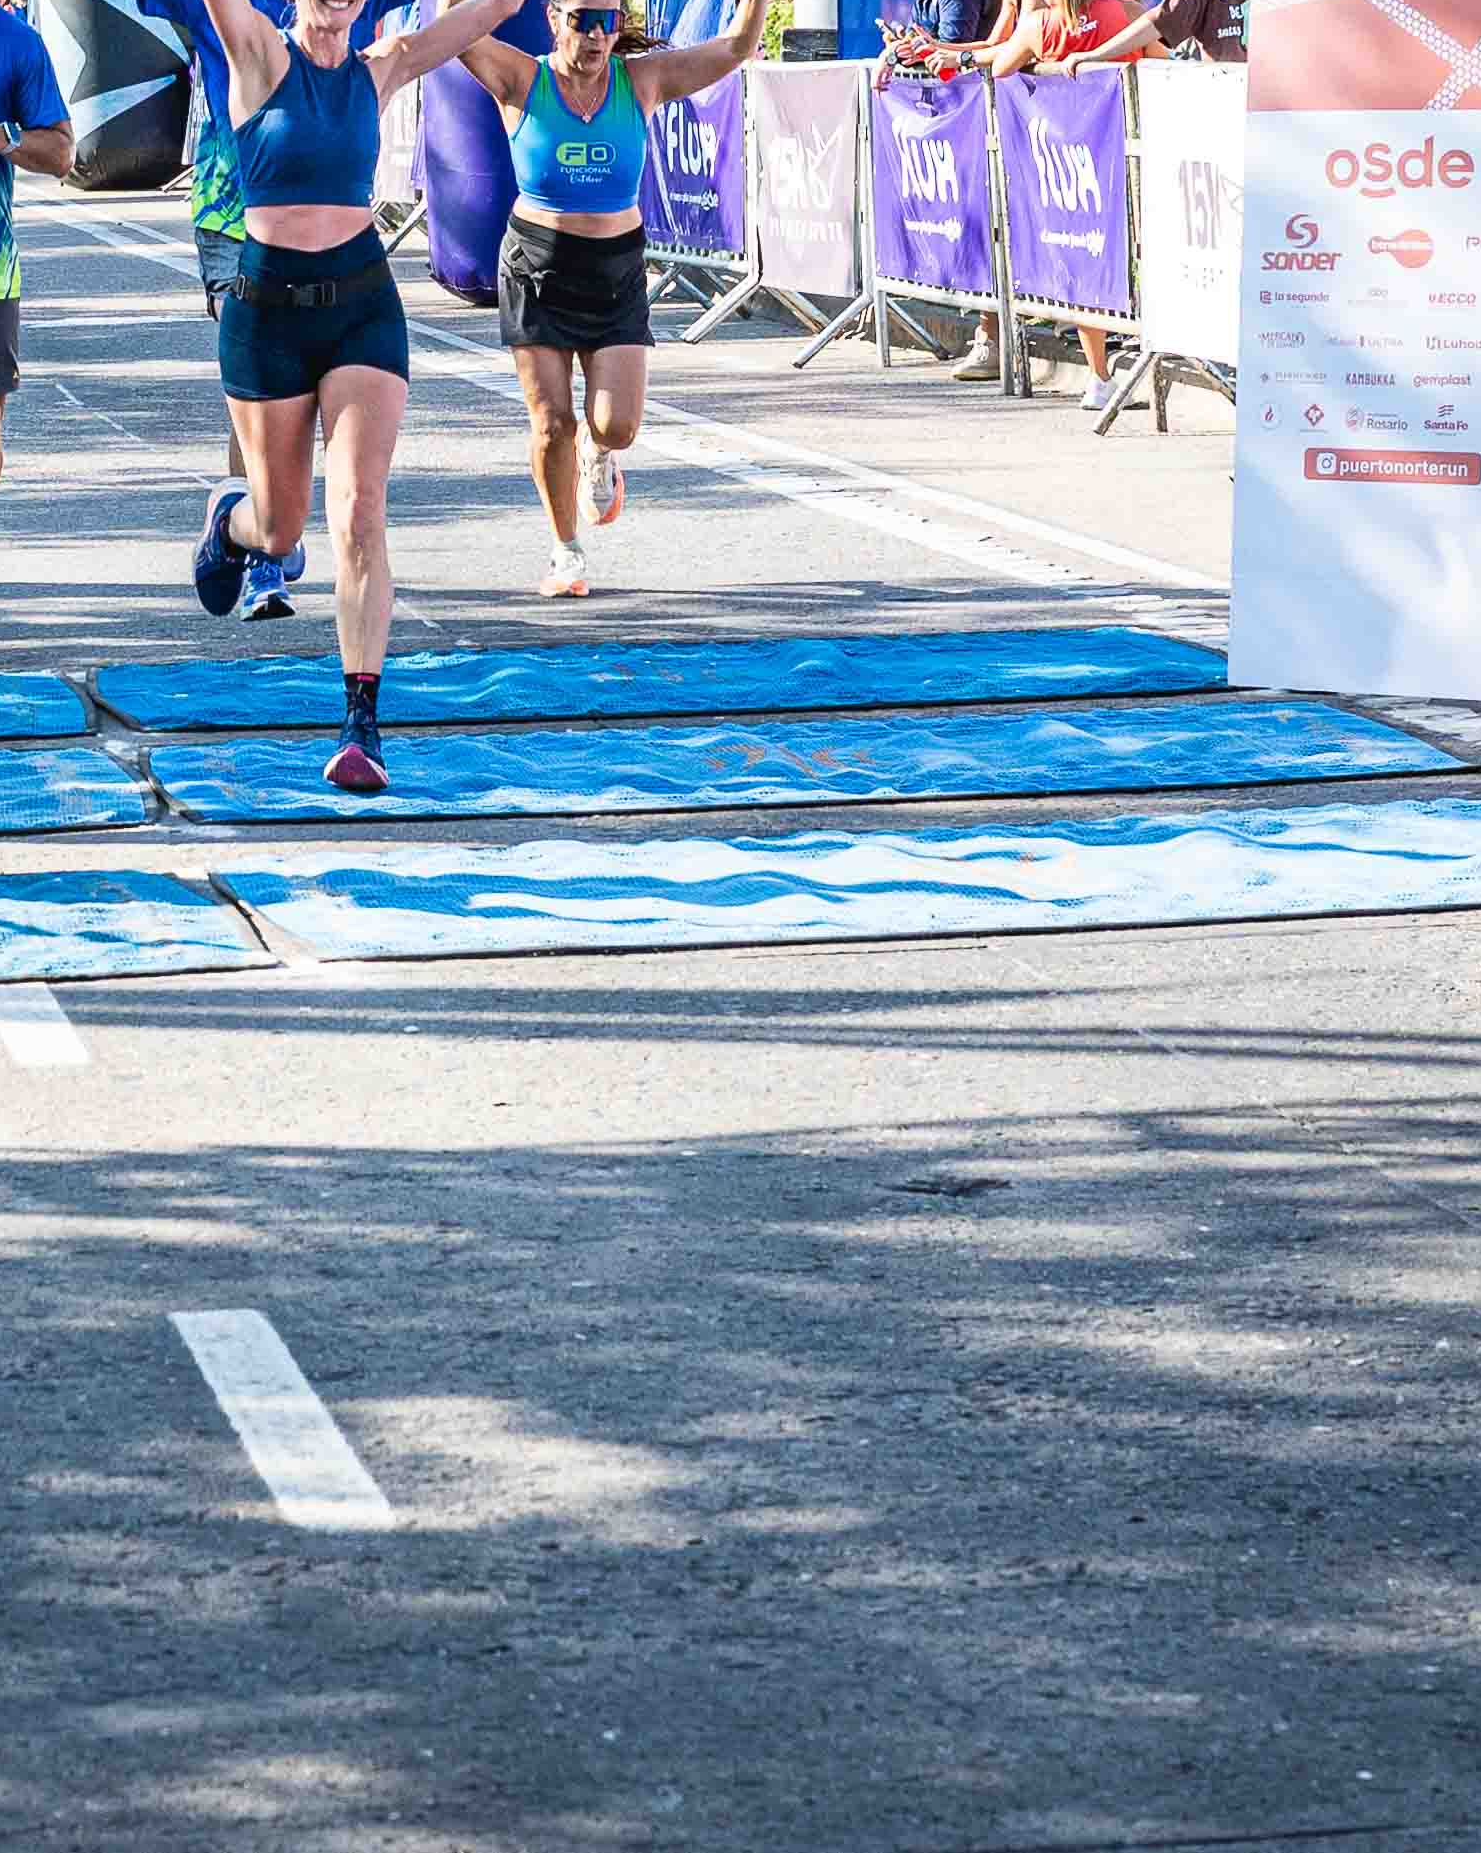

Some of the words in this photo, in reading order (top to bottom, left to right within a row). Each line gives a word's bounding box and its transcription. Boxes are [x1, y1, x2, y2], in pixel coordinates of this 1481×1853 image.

[560, 166, 613, 175] FUNCIONAL
[1325, 135, 1475, 199] osde
[1339, 459, 1469, 478] puertonorterun
